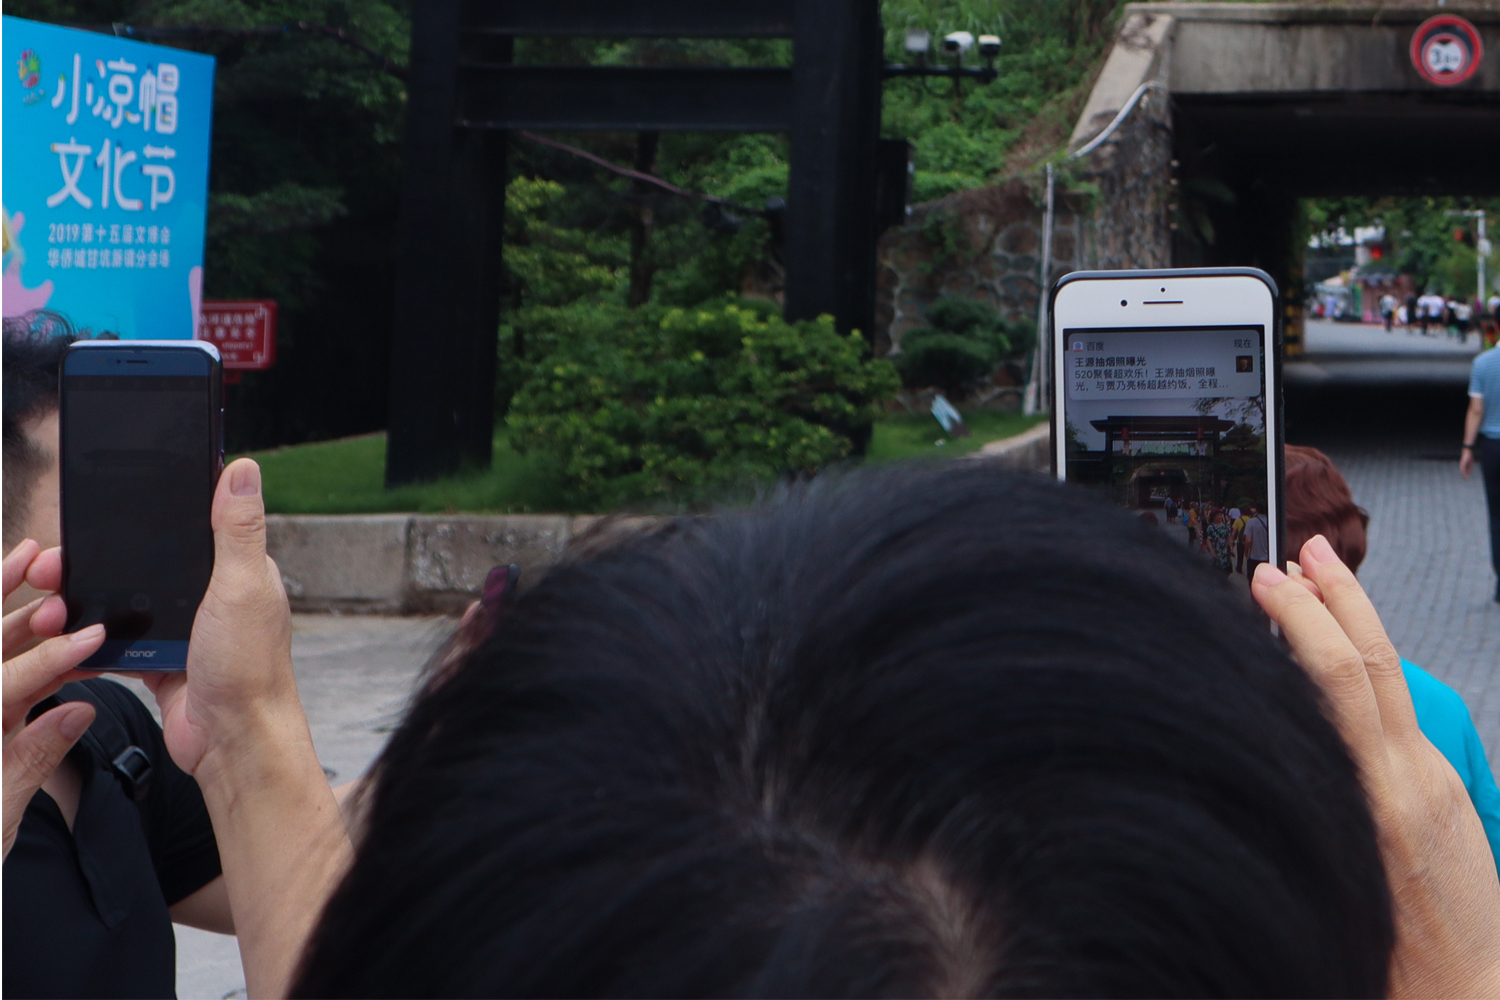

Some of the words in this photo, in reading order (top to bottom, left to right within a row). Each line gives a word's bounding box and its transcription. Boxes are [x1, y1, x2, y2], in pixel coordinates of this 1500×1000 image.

[51, 53, 180, 134] 小凉帽
[46, 137, 176, 211] 文化节
[1086, 341, 1105, 351] 百度
[1233, 338, 1252, 349] 现在
[1074, 356, 1147, 368] 王源抽烟照曝光
[124, 648, 157, 658] honor
